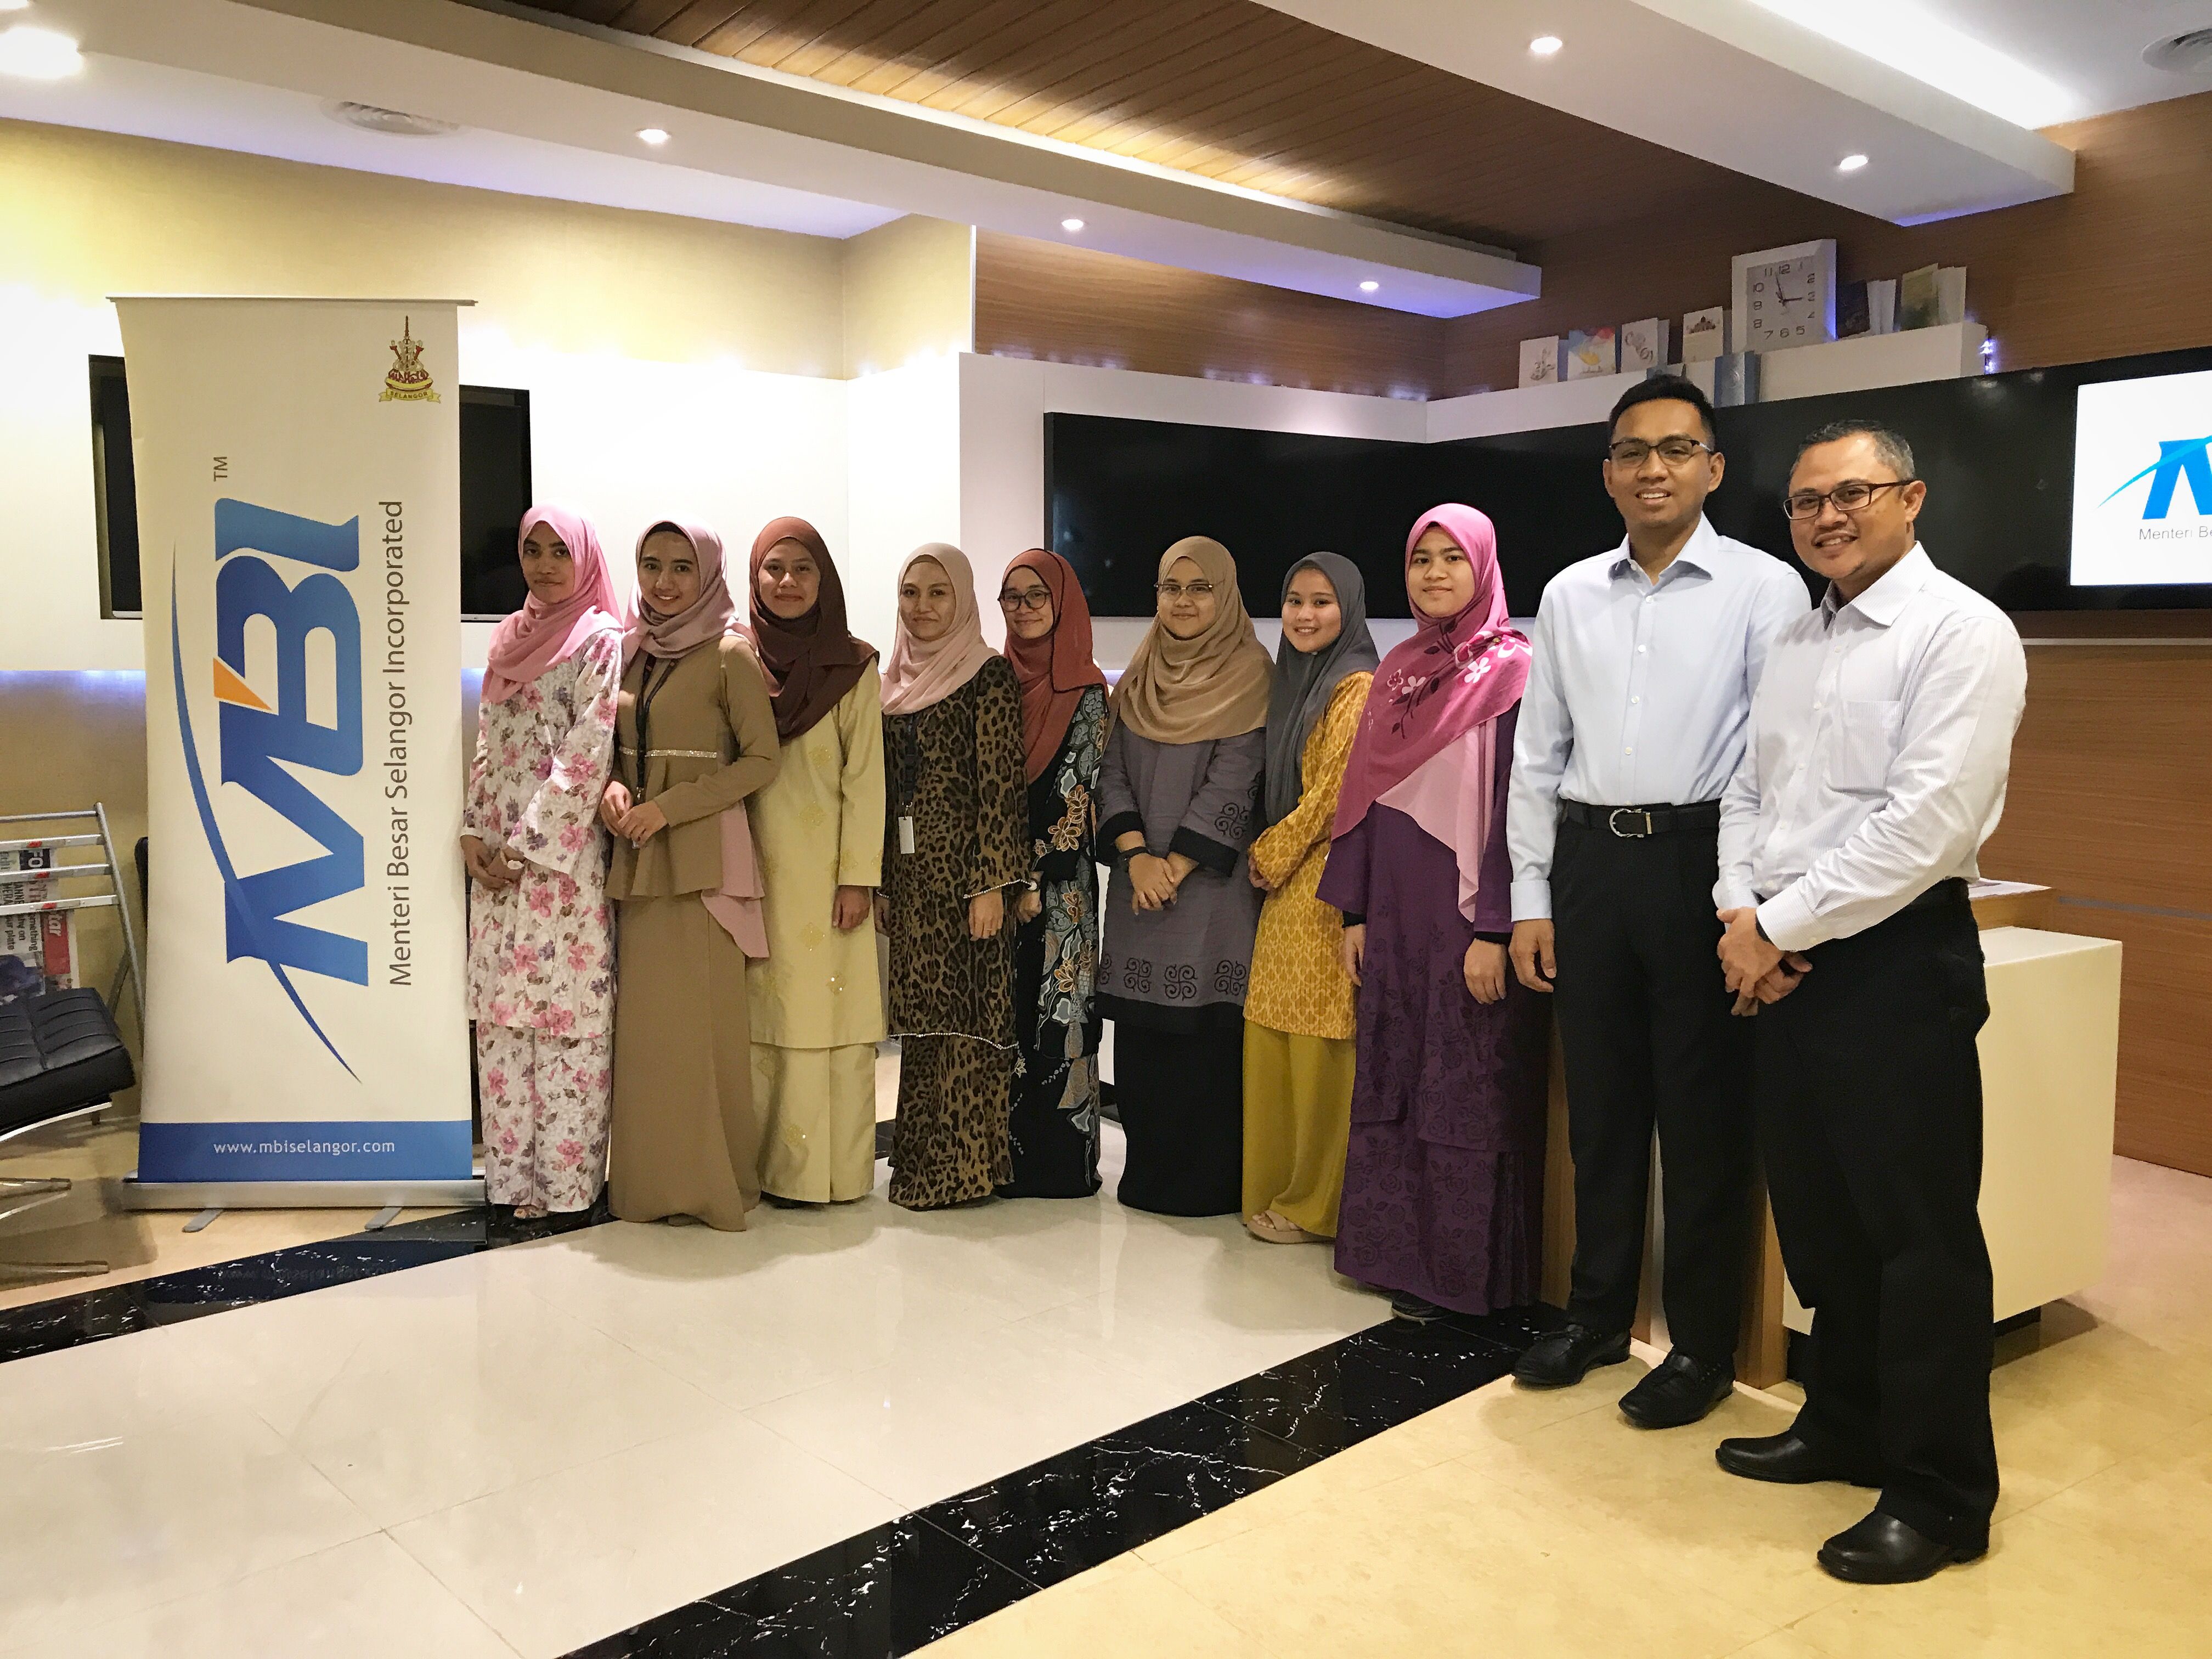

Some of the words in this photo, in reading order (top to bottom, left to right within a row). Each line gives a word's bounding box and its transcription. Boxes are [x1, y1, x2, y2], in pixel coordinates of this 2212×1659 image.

[1764, 268, 1773, 276] 11
[1779, 264, 1791, 274] 12
[1807, 273, 1815, 283] 2
[1753, 283, 1764, 292] 10
[1753, 301, 1762, 310] 9
[1753, 319, 1762, 329] 8
[1764, 330, 1774, 340] 7
[1780, 328, 1790, 338] 6
[1796, 325, 1805, 335] 5
[2139, 527, 2193, 540] Menteri
[379, 501, 409, 673] Incorporated
[213, 498, 369, 987] MBI
[383, 681, 412, 799] Selangor
[387, 806, 409, 876] Besar
[48, 913, 63, 937] tar
[387, 886, 411, 986] Menteri
[213, 1139, 395, 1156] www.mbiselangor.com
